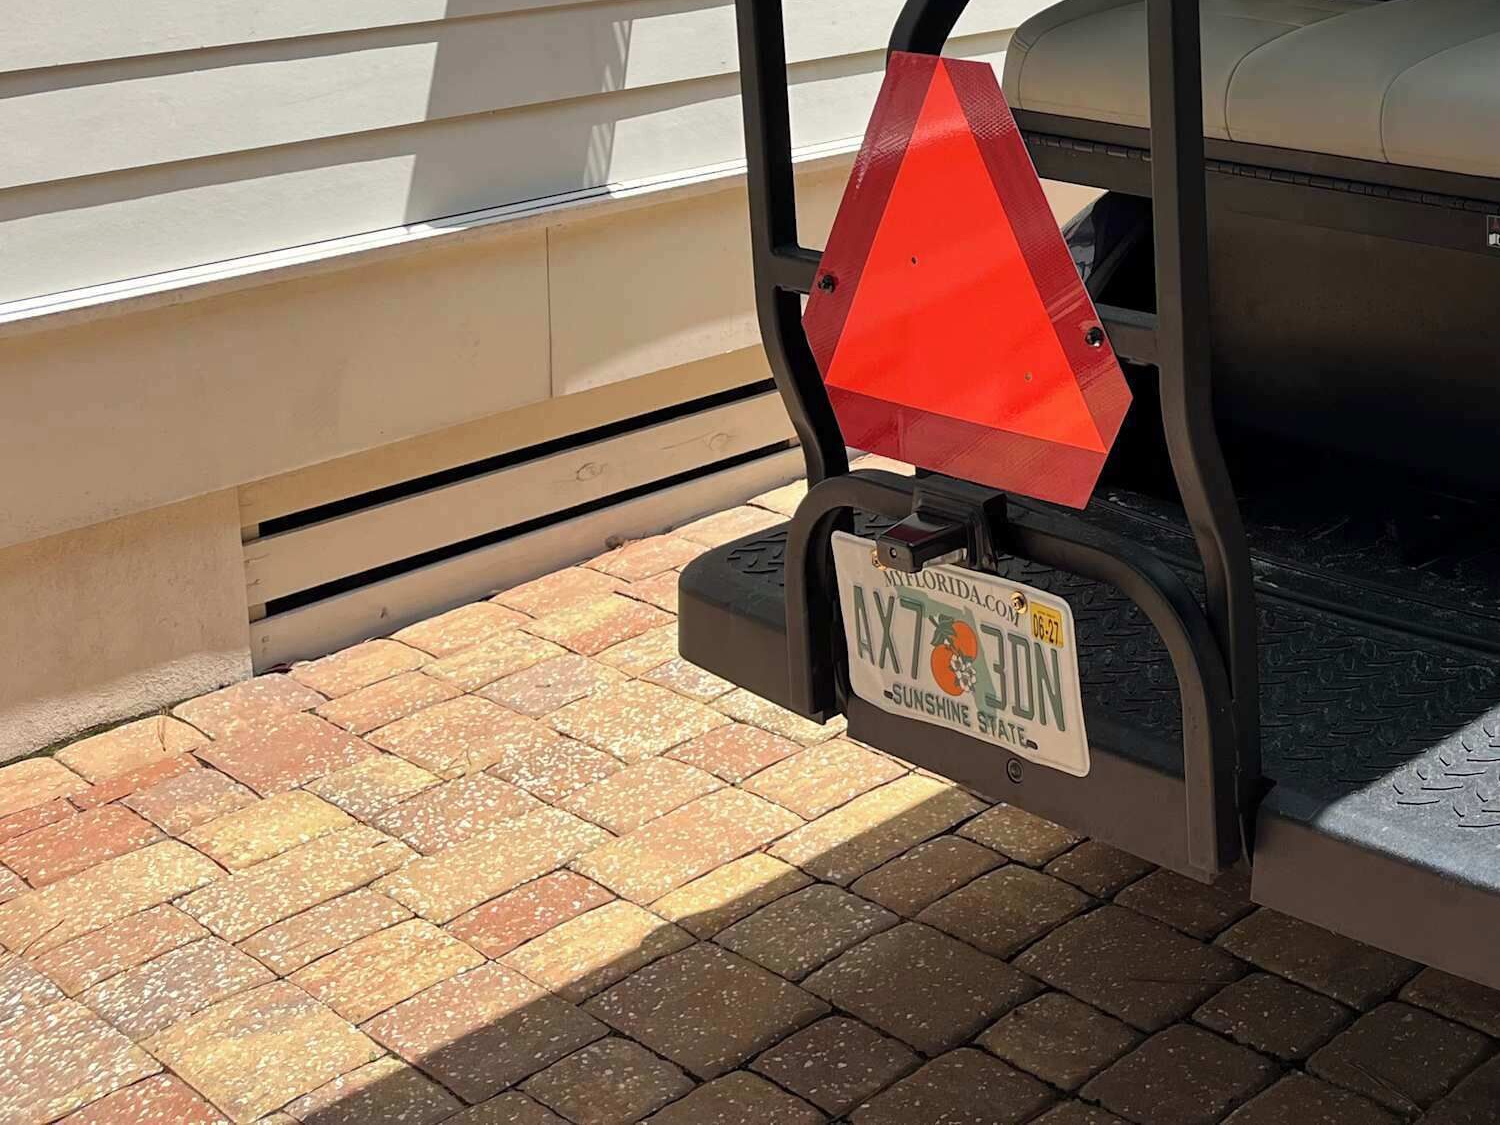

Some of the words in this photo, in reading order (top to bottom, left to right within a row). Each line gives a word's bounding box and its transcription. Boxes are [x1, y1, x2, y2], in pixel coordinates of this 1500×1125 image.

[882, 568, 1020, 627] MYFLORIDA.COM
[852, 584, 924, 681] AX7
[979, 622, 1066, 732] 3DN
[890, 681, 971, 727] SUNSHINE
[976, 709, 1028, 748] STATE
